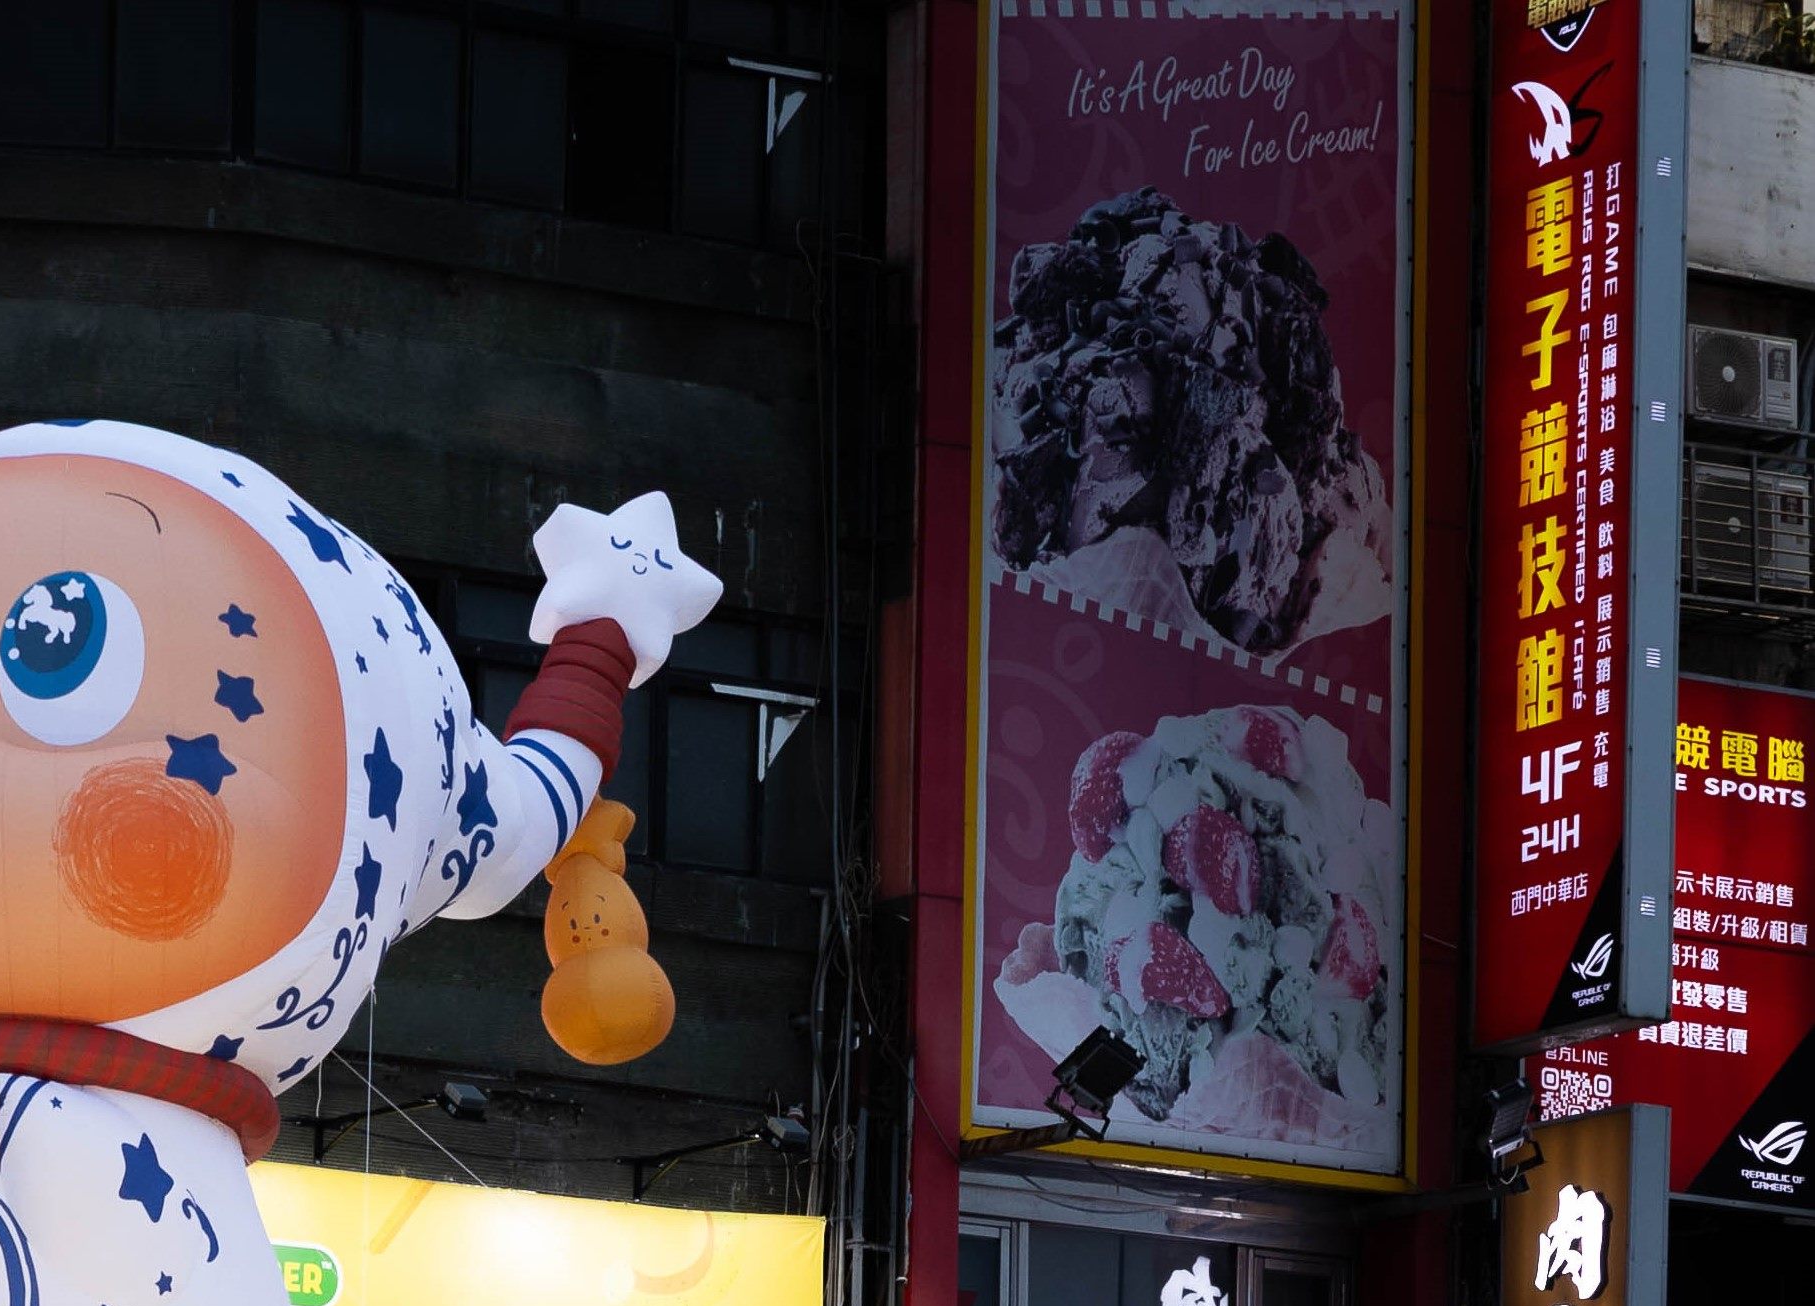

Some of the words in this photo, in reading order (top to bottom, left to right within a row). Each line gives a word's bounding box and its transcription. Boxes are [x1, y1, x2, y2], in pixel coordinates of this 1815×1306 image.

[1068, 68, 1115, 117] It's
[1119, 60, 1147, 112] A
[1153, 56, 1233, 122] Great
[1239, 47, 1295, 111] Day
[1184, 124, 1233, 177] For
[1240, 118, 1280, 169] Ice
[1286, 100, 1383, 164] Cream!
[1582, 169, 1594, 245] ASUS
[1580, 254, 1592, 313] ROG
[1577, 322, 1590, 463] E-SPORTS
[1516, 175, 1573, 732] 電子競技館
[1598, 447, 1616, 506] 美食
[1574, 470, 1586, 604] CERTIFIED
[1597, 520, 1614, 580] 飲料
[1595, 593, 1613, 716] 展示銷售
[1520, 740, 1583, 804] 4F
[1593, 731, 1611, 789] 充電
[1703, 777, 1807, 808] SPORTS
[1521, 813, 1581, 863] 24H
[1511, 872, 1589, 916] 西門中華店
[1740, 1168, 1791, 1183] REPUBLIC
[1792, 1175, 1806, 1184] OF
[1751, 1180, 1794, 1194] GAMERS
